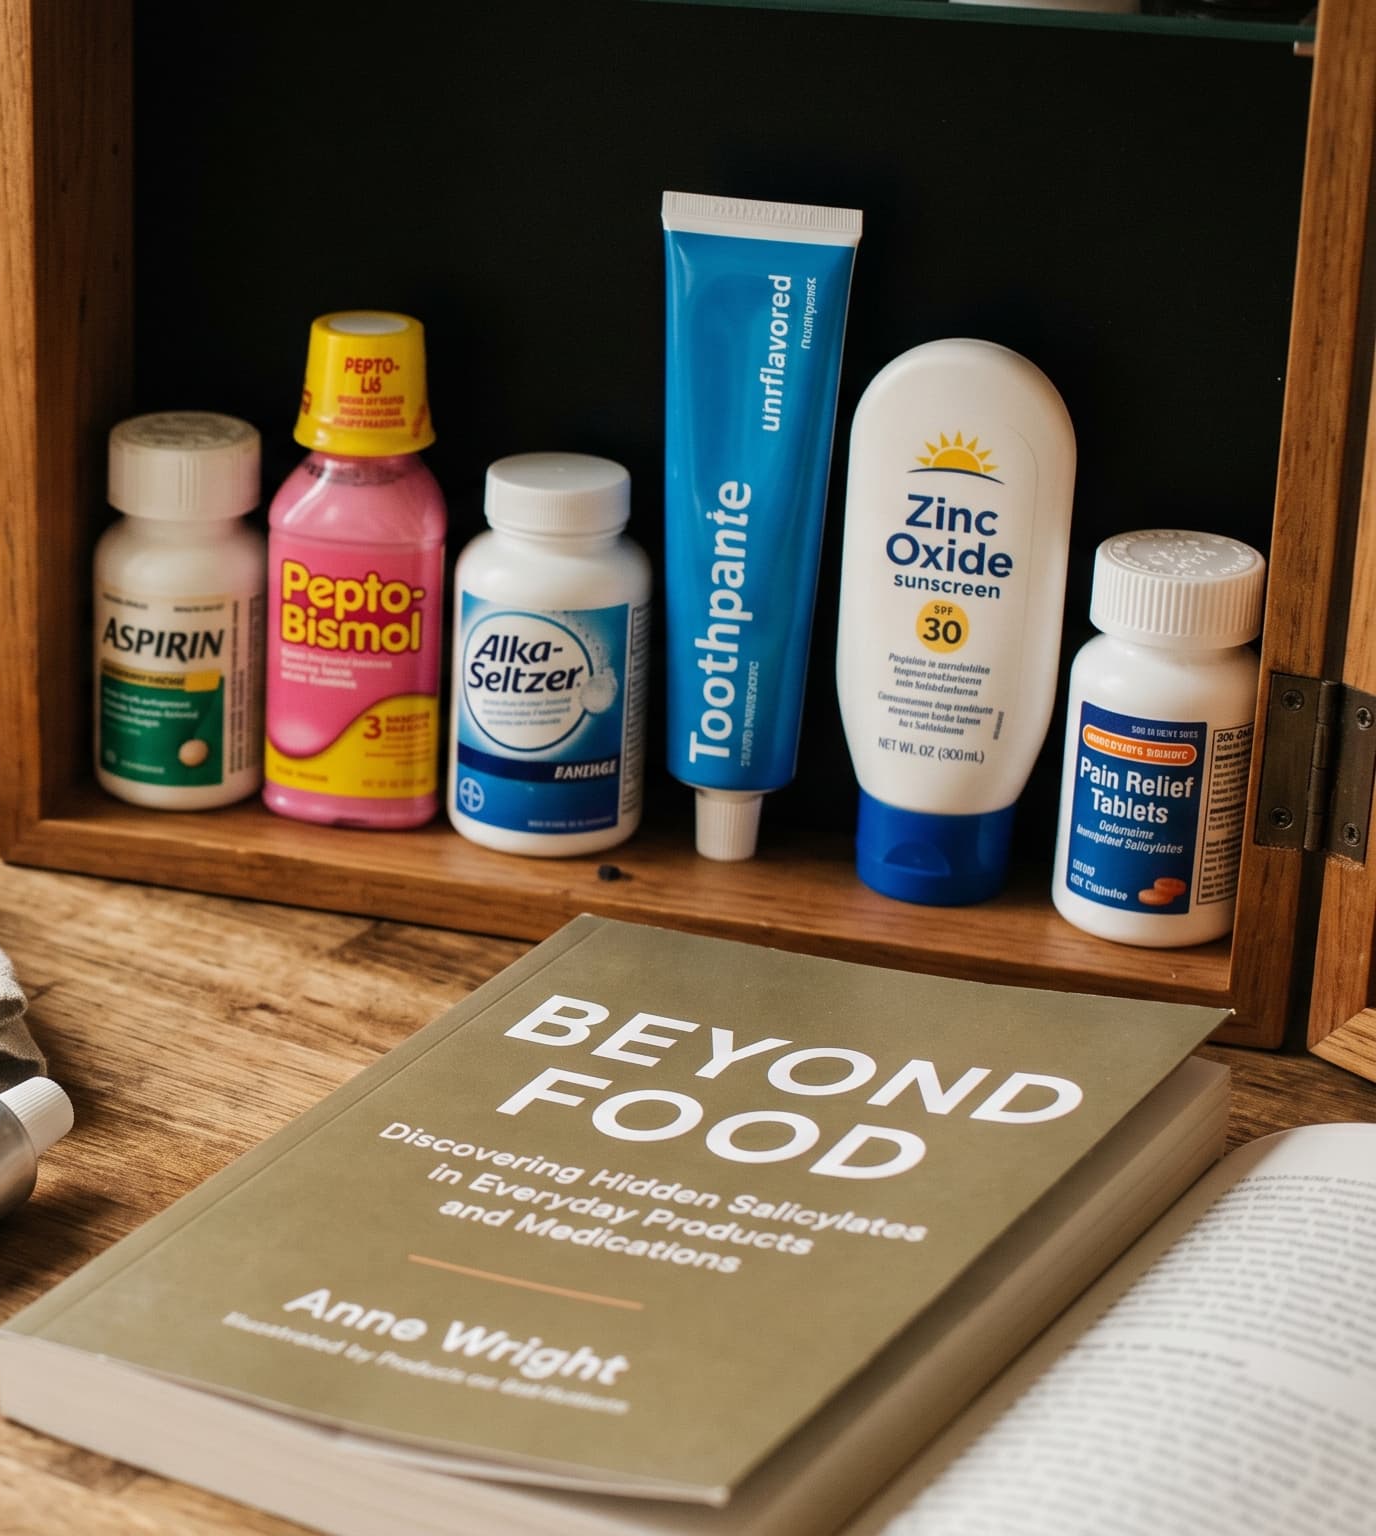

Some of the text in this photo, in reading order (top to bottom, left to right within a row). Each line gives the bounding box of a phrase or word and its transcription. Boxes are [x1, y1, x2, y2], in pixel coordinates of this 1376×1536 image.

[905, 493, 999, 537] Zinc
[886, 532, 1013, 578] Oxide
[282, 560, 425, 621] Pepto-
[893, 573, 1001, 600] sunscreen
[281, 602, 421, 653] Bismol
[922, 617, 963, 645] 30
[934, 604, 954, 616] SPF
[102, 616, 225, 663] ASPIRIN
[475, 634, 564, 665] Alka-
[363, 715, 382, 740] 3
[878, 737, 897, 752] NET
[1079, 756, 1194, 798] Pain Relief
[1091, 787, 1169, 824] Tablets
[504, 994, 1083, 1124] BEYOND
[496, 1067, 926, 1180] FOOD
[379, 1122, 928, 1242] Discovering Hidden Salicylates
[427, 1163, 814, 1255] in Everyday Products
[439, 1199, 742, 1273] and Medications
[282, 1287, 630, 1386] Anne Wright
